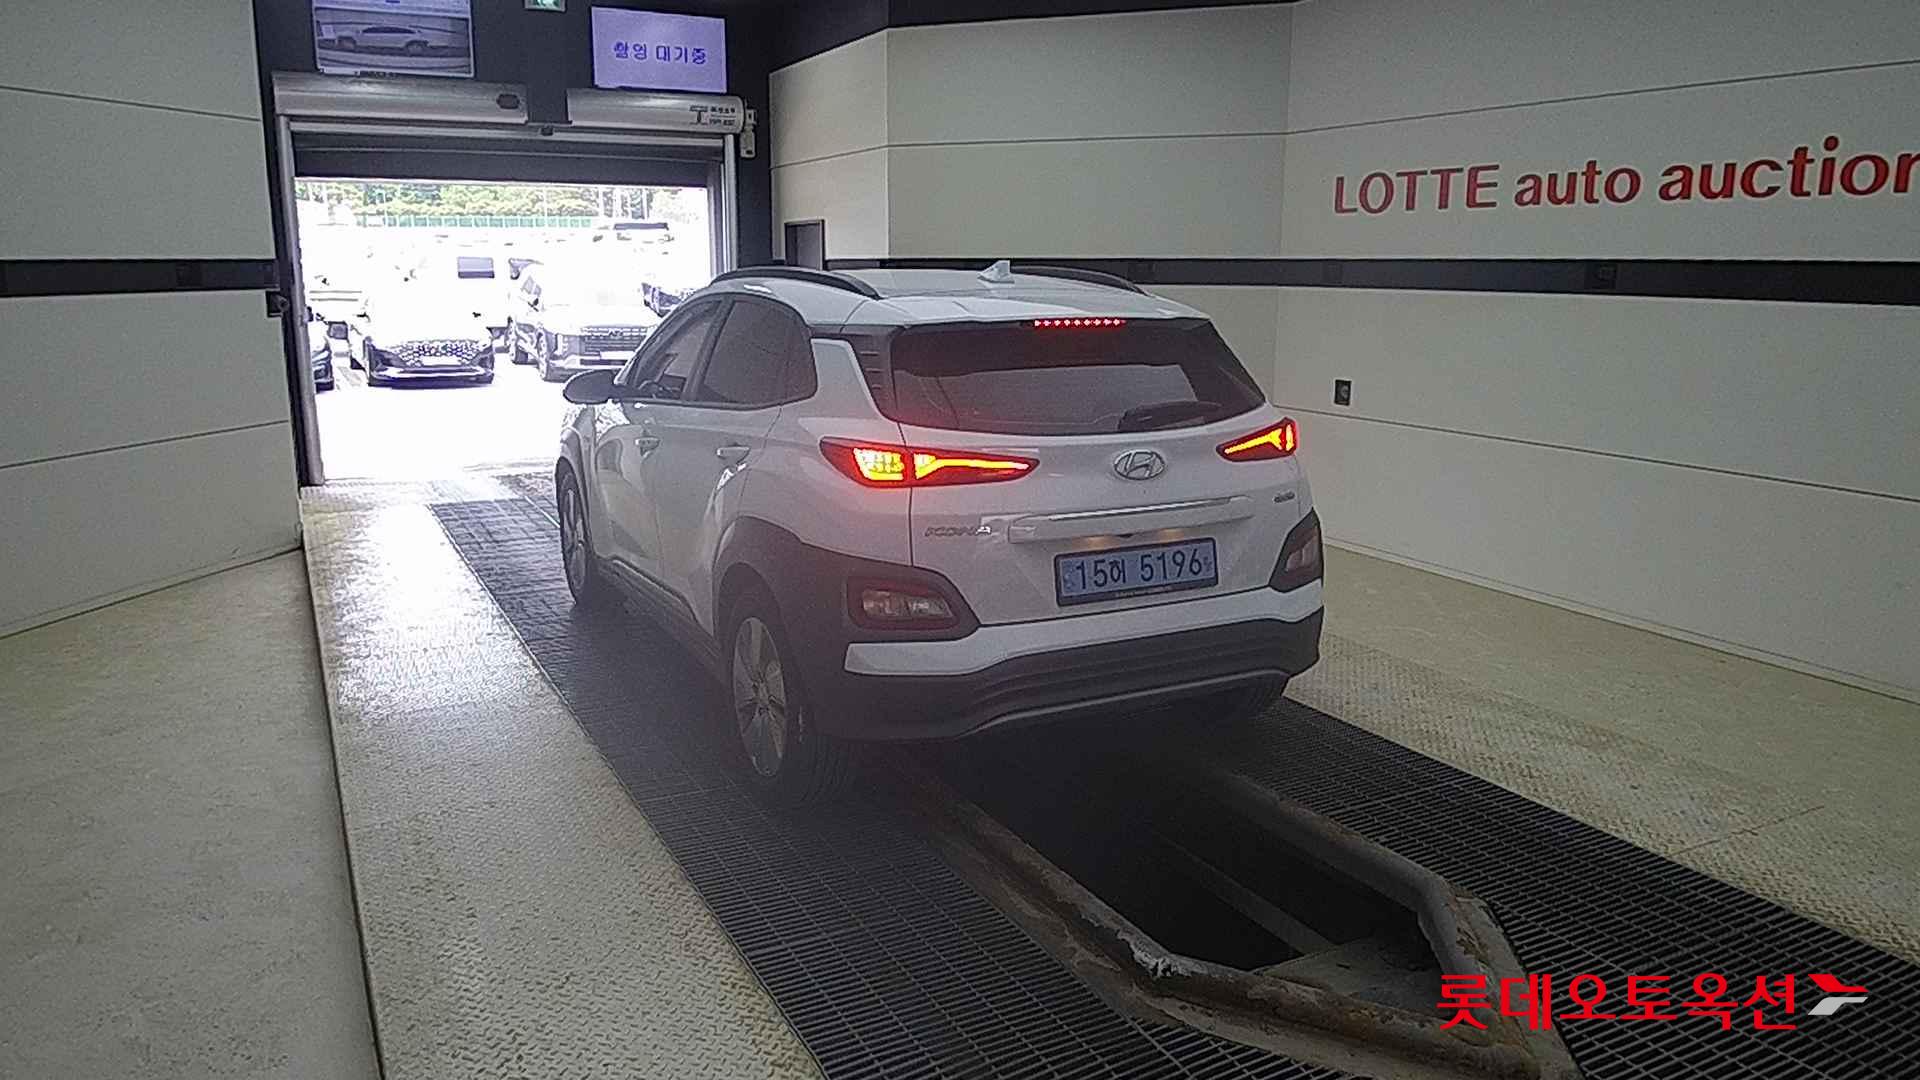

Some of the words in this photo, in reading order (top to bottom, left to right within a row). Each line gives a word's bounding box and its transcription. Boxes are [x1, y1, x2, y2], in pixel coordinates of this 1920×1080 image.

[655, 45, 706, 65] 대기중
[1334, 163, 1500, 214] LOTTE
[1514, 160, 1641, 207] auto
[1076, 558, 1127, 590] 15허
[1139, 548, 1203, 582] 5196
